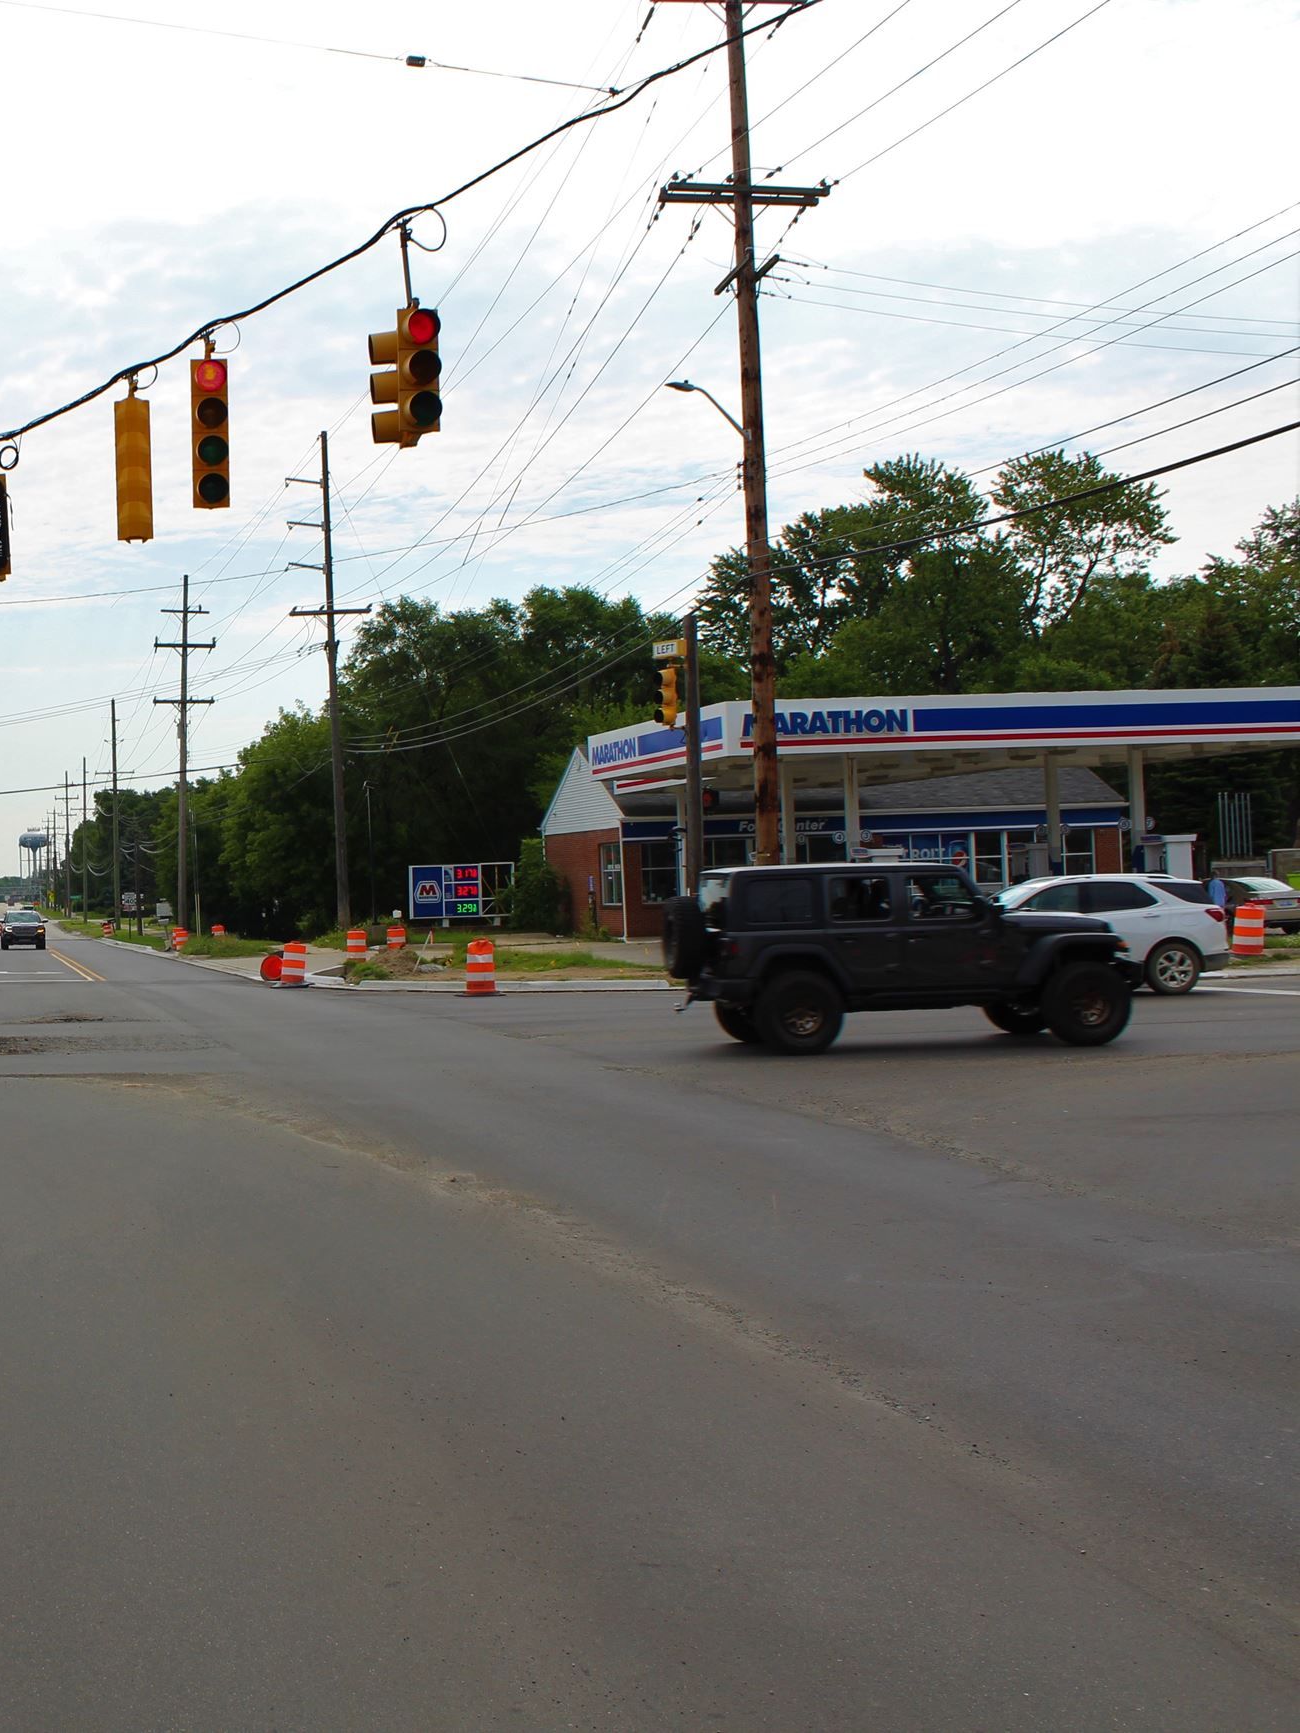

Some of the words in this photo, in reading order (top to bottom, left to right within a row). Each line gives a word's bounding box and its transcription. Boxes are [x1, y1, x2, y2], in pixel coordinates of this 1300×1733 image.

[656, 643, 674, 655] LEFT
[592, 737, 637, 766] MARATHON
[778, 819, 826, 834] nter
